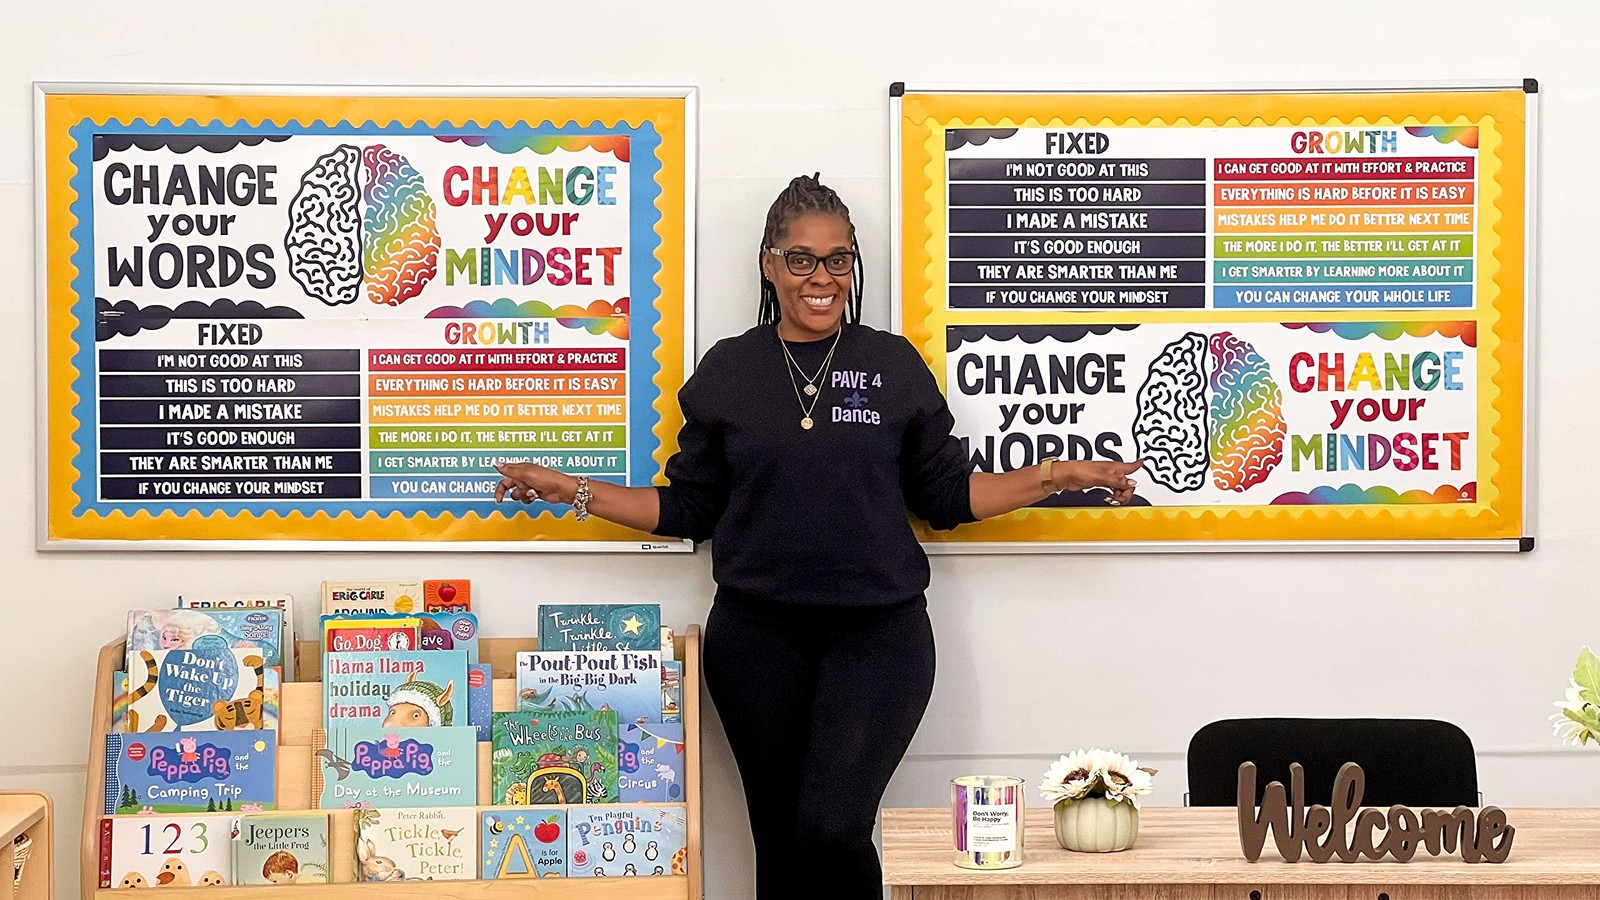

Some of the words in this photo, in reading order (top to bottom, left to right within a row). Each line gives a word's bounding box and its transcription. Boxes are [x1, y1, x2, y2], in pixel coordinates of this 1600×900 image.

[1046, 132, 1110, 155] FIXED
[1291, 130, 1397, 154] GROWTH
[104, 162, 278, 206] CHANGE
[443, 165, 617, 206] CHANGE
[1014, 188, 1044, 202] THIS
[1050, 188, 1062, 202] IS
[1068, 188, 1098, 202] TOO
[1103, 188, 1141, 201] HARD
[147, 214, 236, 243] your
[484, 212, 580, 244] your
[1015, 240, 1040, 254] IT'S
[1044, 240, 1083, 254] GOOD
[1088, 240, 1140, 254] ENOUGH
[108, 243, 276, 289] WORDS
[445, 246, 622, 286] MINDSET
[1223, 268, 1225, 276] I
[1229, 267, 1248, 277] GET
[1252, 266, 1302, 277] SMARTER
[1307, 266, 1320, 276] BY
[1324, 266, 1375, 276] LEARNING
[1379, 266, 1409, 276] MORE
[1413, 265, 1451, 276] ABOUT
[1454, 266, 1464, 276] IT
[986, 291, 996, 303] IF
[1001, 291, 1026, 303] YOU
[1030, 291, 1077, 303] CHANGE
[1081, 291, 1115, 303] YOUR
[1120, 291, 1168, 303] MINDSET
[198, 323, 263, 346] FIXED
[444, 322, 549, 345] GROWTH
[158, 355, 174, 367] I'M
[179, 354, 206, 367] NOT
[210, 354, 248, 367] GOOD
[252, 355, 269, 367] AT
[273, 354, 302, 367] THIS
[832, 370, 867, 390] PAVE
[872, 373, 882, 388] 4
[957, 352, 1126, 396] CHANGE
[1289, 351, 1464, 393] CHANGE
[166, 379, 197, 392] THIS
[202, 379, 216, 392] IS
[221, 378, 252, 392] TOO
[257, 379, 295, 392] HARD
[376, 379, 448, 390] EVERYTHING
[453, 378, 464, 390] IS
[469, 379, 502, 390] HARD
[506, 378, 549, 390] BEFORE
[554, 379, 564, 390] IT
[569, 378, 580, 390] IS
[585, 378, 617, 390] EASY
[160, 405, 164, 419] I
[169, 404, 211, 419] MADE
[217, 404, 229, 419] A
[234, 404, 302, 419] MISTAKE
[832, 406, 880, 425] Dance
[998, 402, 1086, 432] your
[1330, 398, 1426, 430] your
[1291, 432, 1469, 472] MINDSET
[130, 457, 164, 470] THEY
[169, 456, 197, 470] ARE
[202, 456, 268, 470] SMARTER
[273, 456, 311, 469] THAN
[315, 456, 332, 469] ME
[392, 481, 418, 493] YOU
[422, 481, 446, 493] CAN
[449, 481, 495, 493] CHANGE
[359, 590, 384, 600] CARLE
[333, 635, 354, 651] Go,
[182, 652, 225, 671] Don't
[330, 659, 374, 674] llama
[380, 658, 425, 674] llama
[528, 654, 618, 672] Pout-Pout
[621, 653, 658, 671] Fish
[165, 663, 209, 682] Wake
[211, 671, 234, 691] Up
[560, 673, 606, 691] Big-Big
[608, 673, 637, 685] Dark
[165, 687, 209, 708] Tiger
[183, 682, 201, 694] the
[330, 680, 391, 700] holiday
[330, 703, 381, 718] drama
[509, 724, 558, 746] Wheels
[575, 724, 601, 741] Bus
[152, 748, 201, 781] Peppa
[203, 748, 227, 774] Pig
[356, 744, 404, 775] Peppa
[406, 743, 430, 768] Pig
[147, 785, 209, 801] Camping
[214, 784, 242, 798] Trip
[334, 784, 361, 799] Day
[366, 787, 377, 797] at
[383, 786, 401, 797] the
[407, 783, 461, 796] Museum
[619, 776, 657, 789] Circus
[588, 814, 603, 823] Ten
[605, 812, 633, 820] Playful
[1238, 761, 1516, 863] Welcome
[141, 824, 154, 854] 1
[162, 823, 183, 854] 2
[190, 822, 208, 854] 3
[244, 824, 309, 846] Jeepers
[576, 816, 662, 846] Penguins
[406, 842, 462, 858] Tickle,
[496, 834, 537, 879] A
[420, 861, 464, 874] Peter!
[538, 858, 562, 866] Apple
